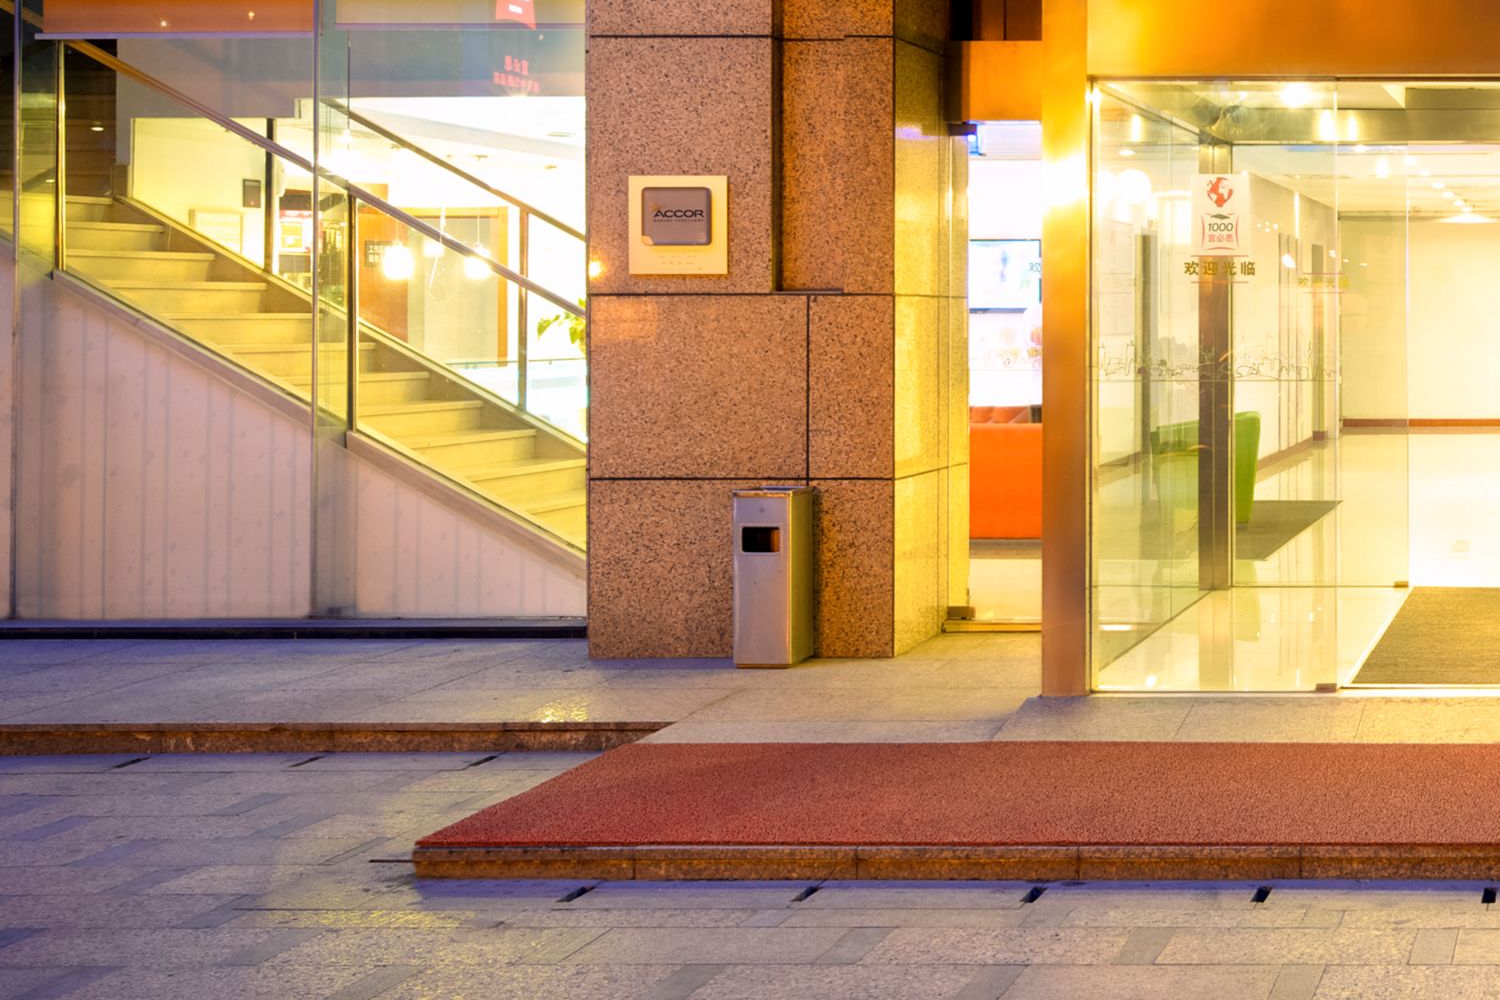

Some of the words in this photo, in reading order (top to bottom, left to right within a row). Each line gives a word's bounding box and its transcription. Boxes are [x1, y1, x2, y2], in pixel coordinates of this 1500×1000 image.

[653, 209, 704, 218] ACCOR
[1208, 222, 1234, 232] 1000
[1184, 261, 1256, 276] 欢迎光临
